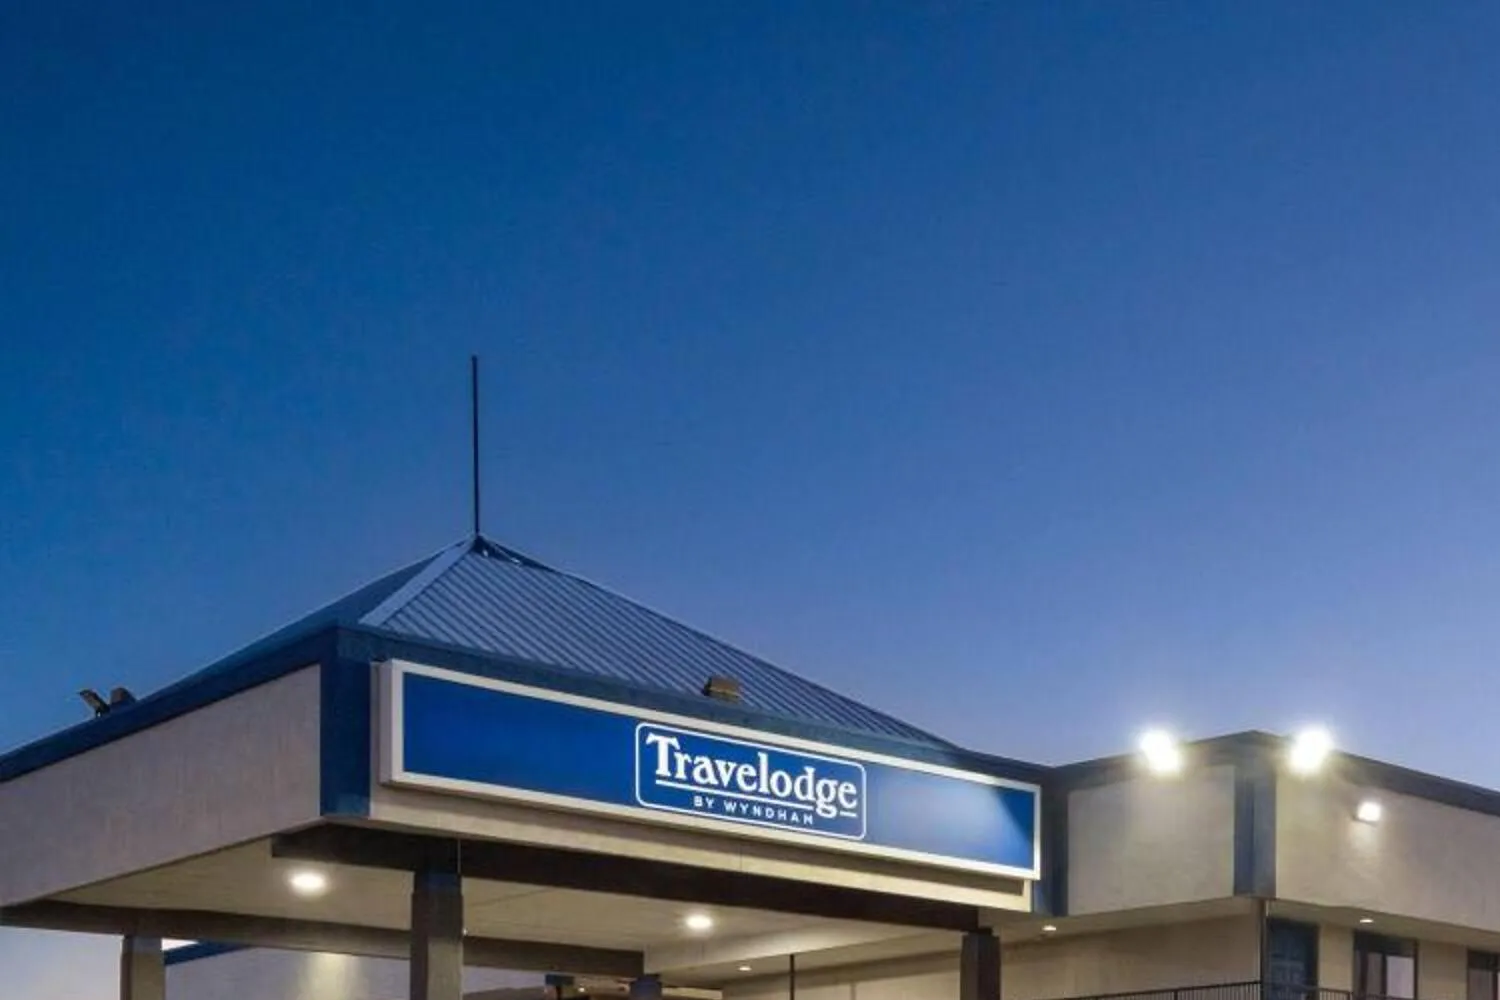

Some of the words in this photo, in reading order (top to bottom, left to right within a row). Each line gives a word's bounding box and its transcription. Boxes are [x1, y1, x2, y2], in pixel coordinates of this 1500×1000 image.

[646, 733, 857, 818] Travelodge
[693, 796, 715, 809] BY
[724, 800, 814, 825] WYNDHAM
